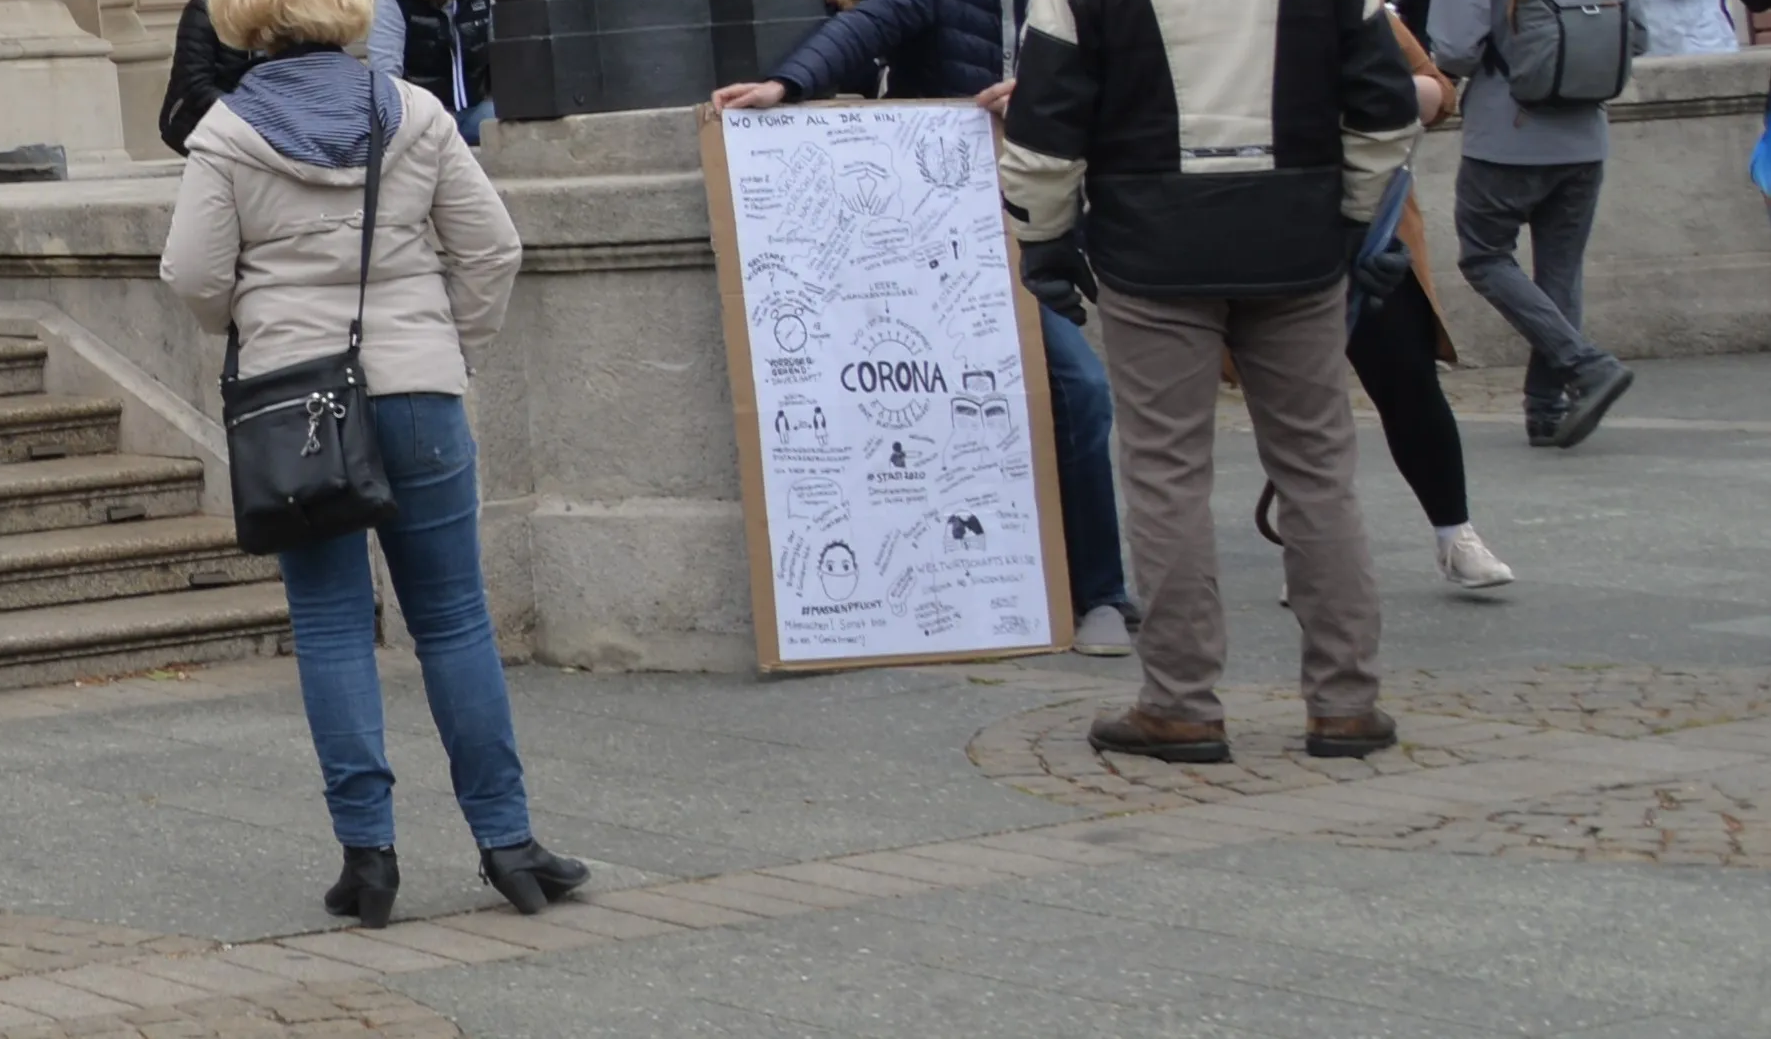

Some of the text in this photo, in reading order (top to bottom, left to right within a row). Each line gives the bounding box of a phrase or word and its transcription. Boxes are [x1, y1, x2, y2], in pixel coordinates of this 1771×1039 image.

[729, 116, 751, 129] WO
[806, 113, 829, 126] ALL
[839, 112, 863, 123] DAS
[840, 359, 949, 394] CORONA
